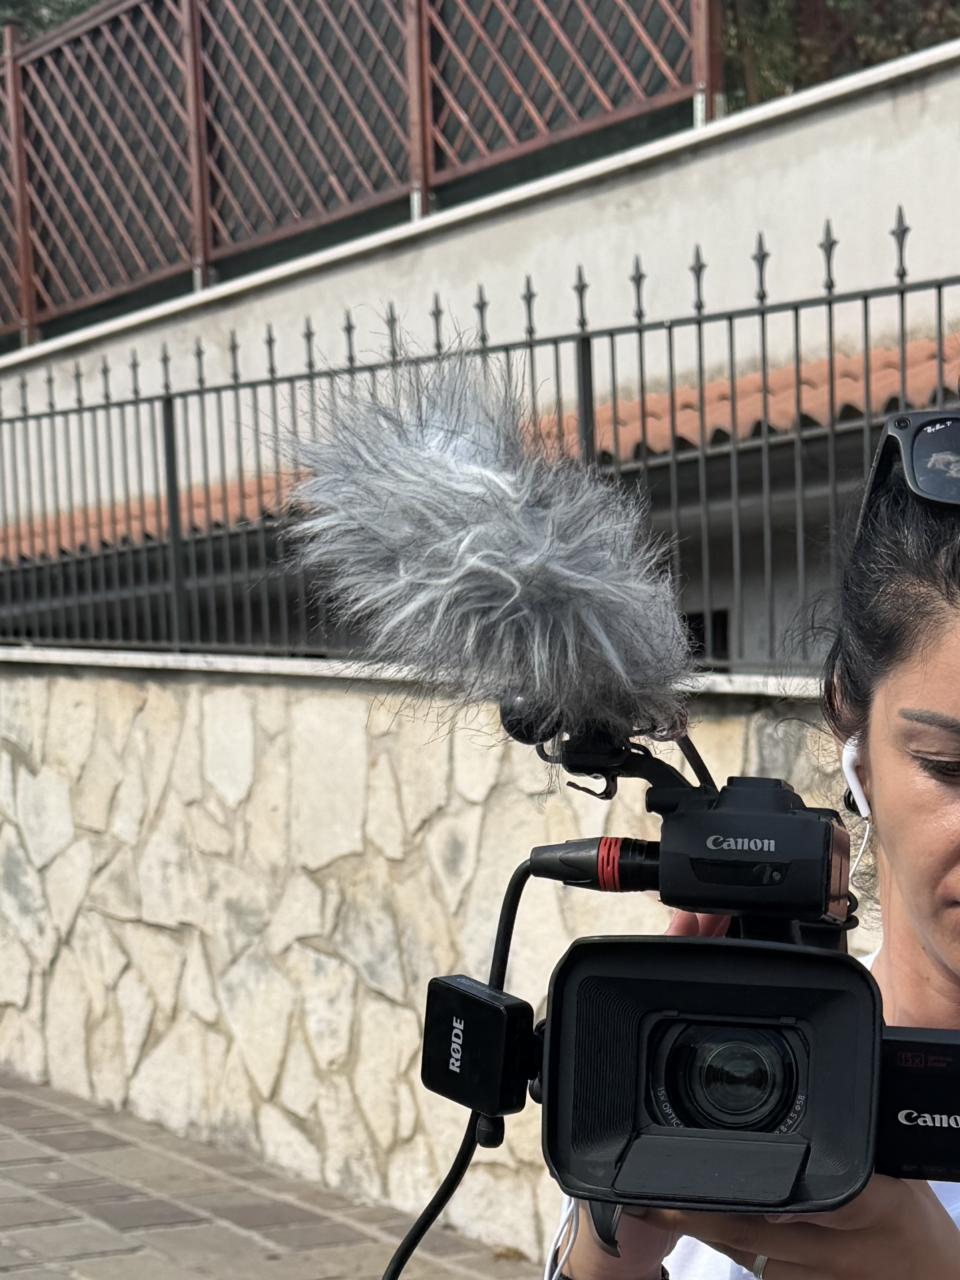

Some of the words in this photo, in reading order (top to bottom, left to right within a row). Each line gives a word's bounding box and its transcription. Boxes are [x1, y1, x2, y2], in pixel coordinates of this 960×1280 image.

[705, 834, 776, 853] Canon
[448, 1016, 464, 1074] RØDE
[661, 1102, 684, 1129] OPTIC
